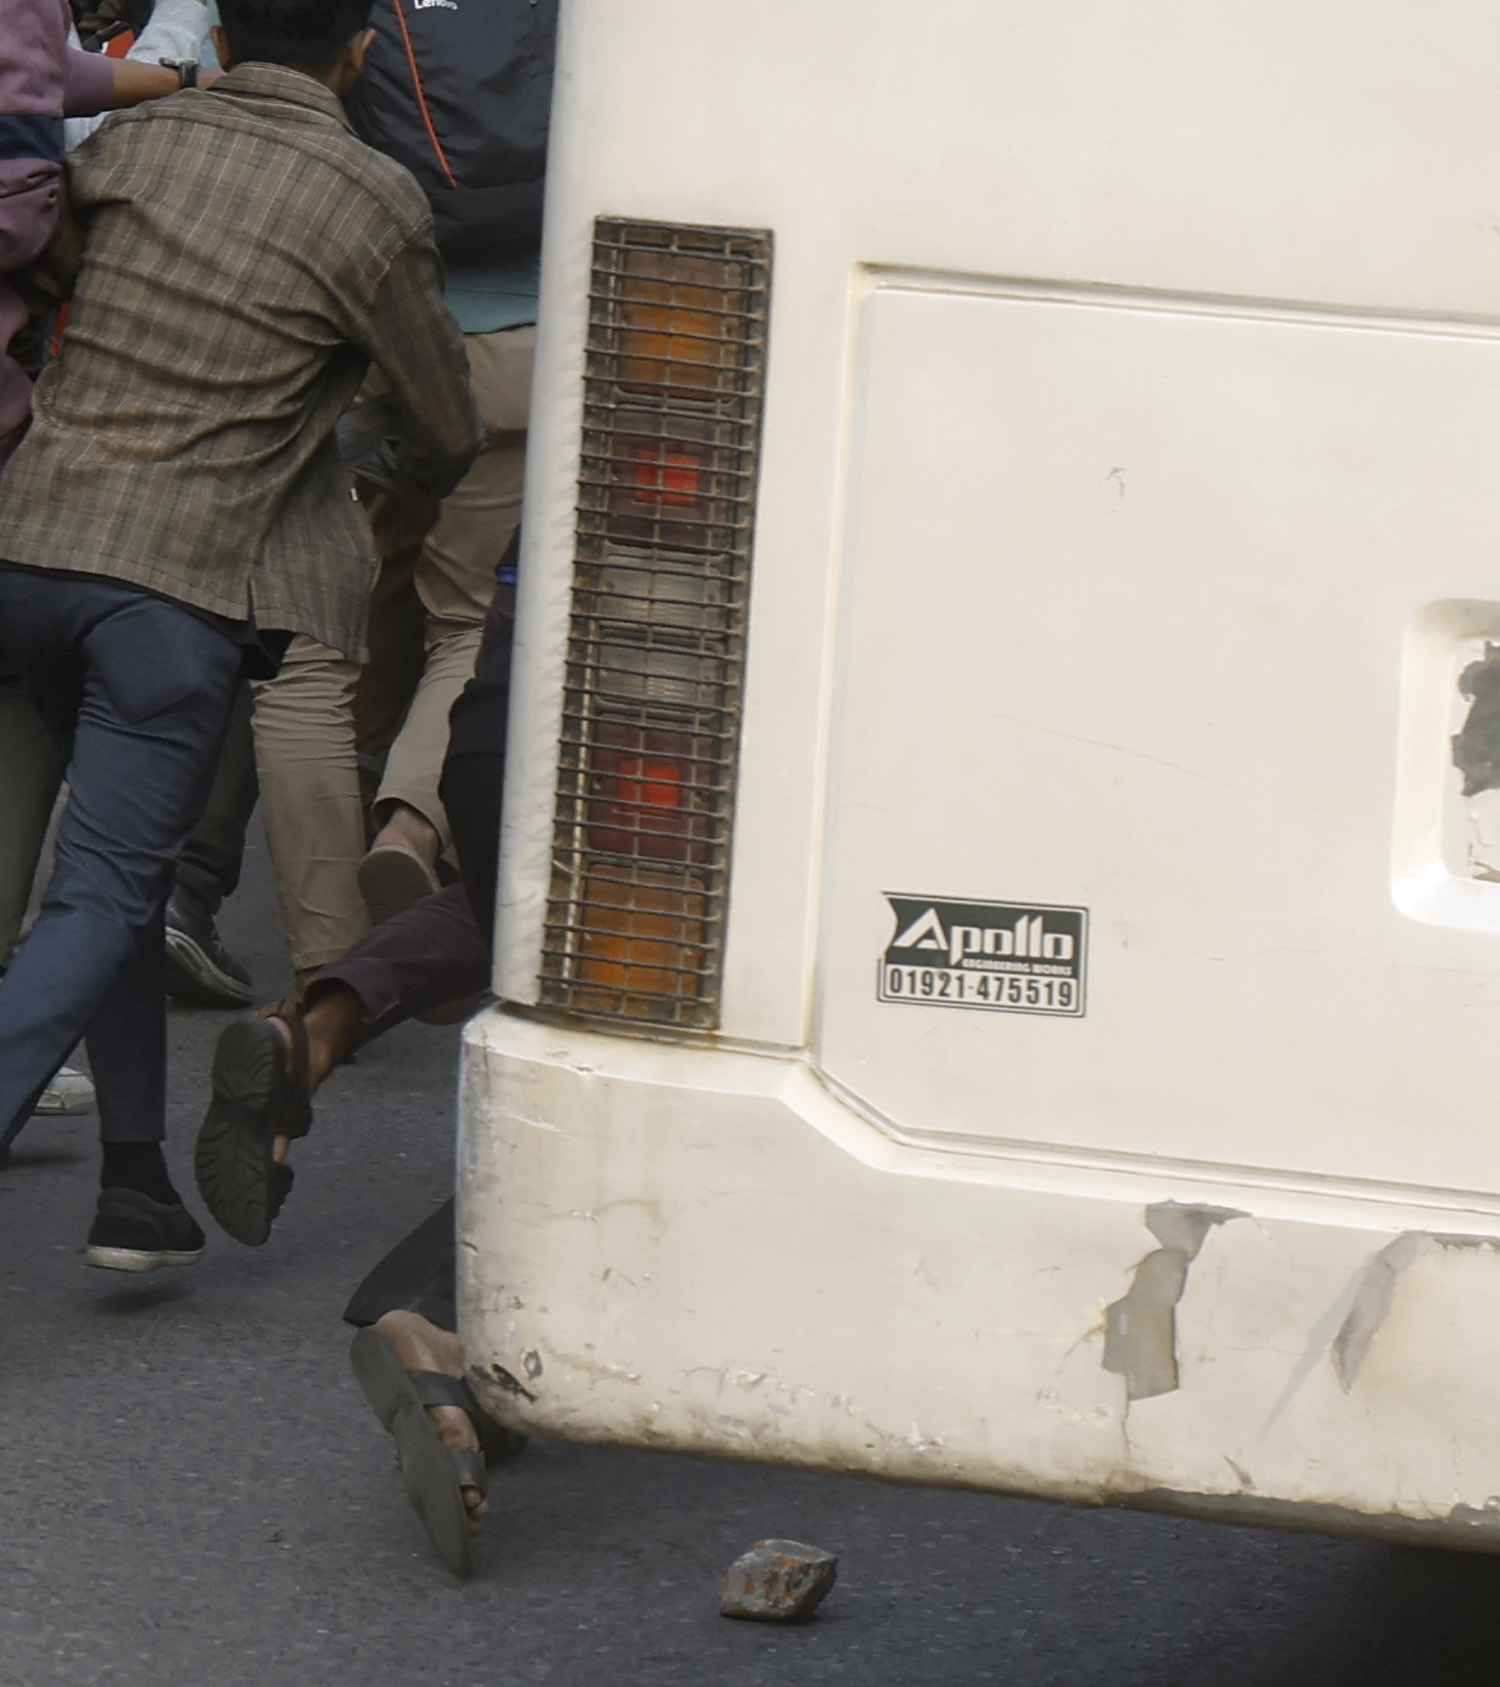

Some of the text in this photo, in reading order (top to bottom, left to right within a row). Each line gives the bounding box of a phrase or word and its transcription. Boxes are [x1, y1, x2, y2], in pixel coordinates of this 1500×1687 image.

[892, 907, 1074, 967] Apollo
[888, 967, 1073, 1008] 01921-475519
[1033, 963, 1074, 977] WORKS
